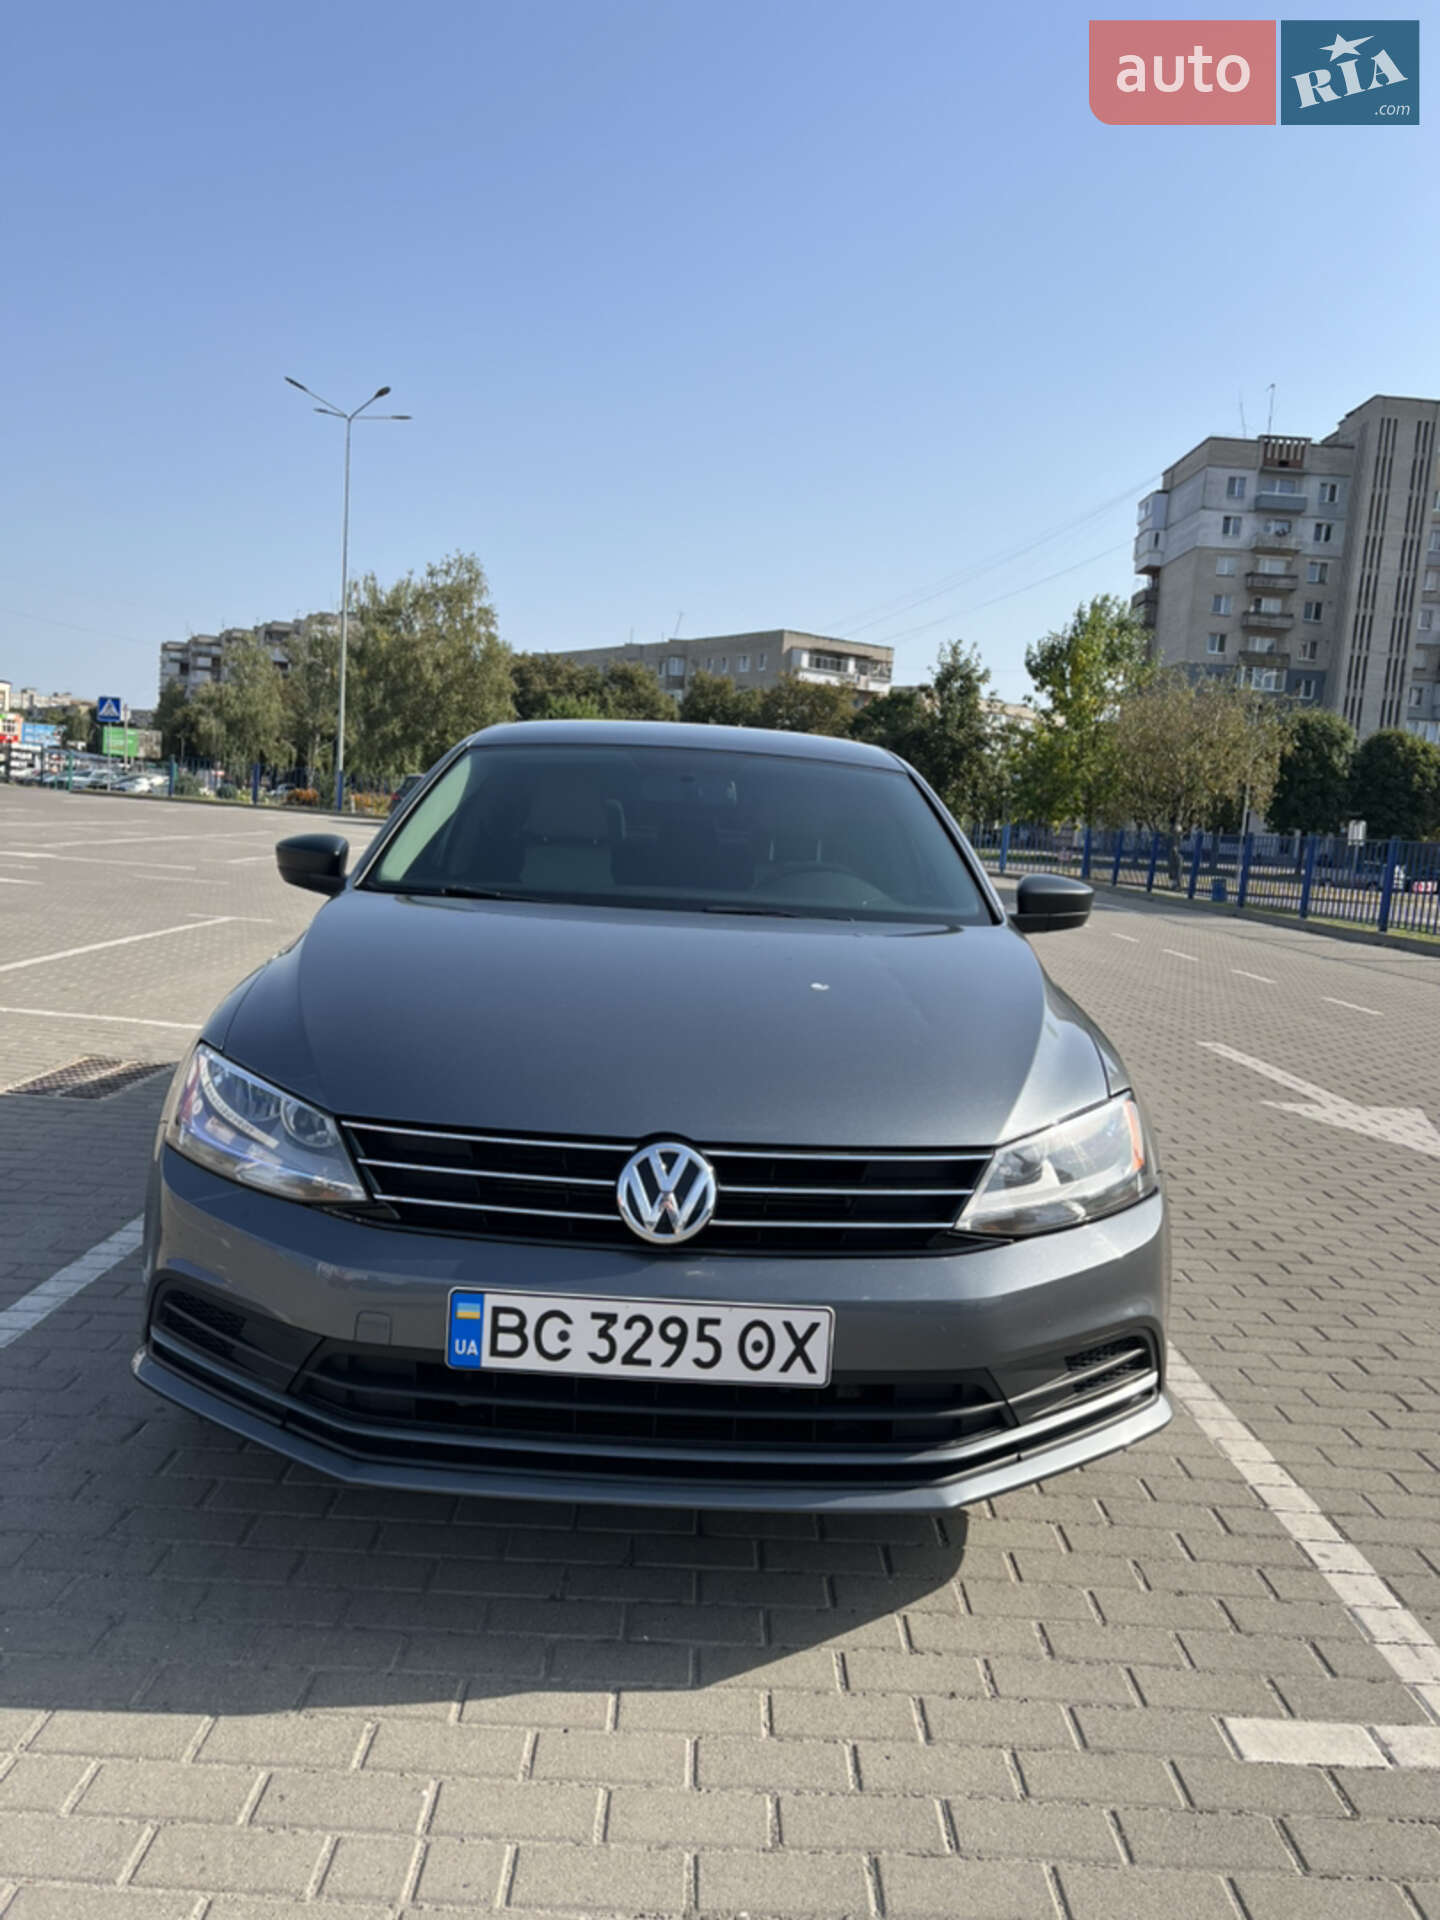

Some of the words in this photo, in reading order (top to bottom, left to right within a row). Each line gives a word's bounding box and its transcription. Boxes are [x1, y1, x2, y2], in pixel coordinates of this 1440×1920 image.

[455, 1339, 479, 1356] UA
[489, 1306, 574, 1362] BC
[587, 1311, 722, 1369] 3295
[738, 1319, 821, 1374] OX
